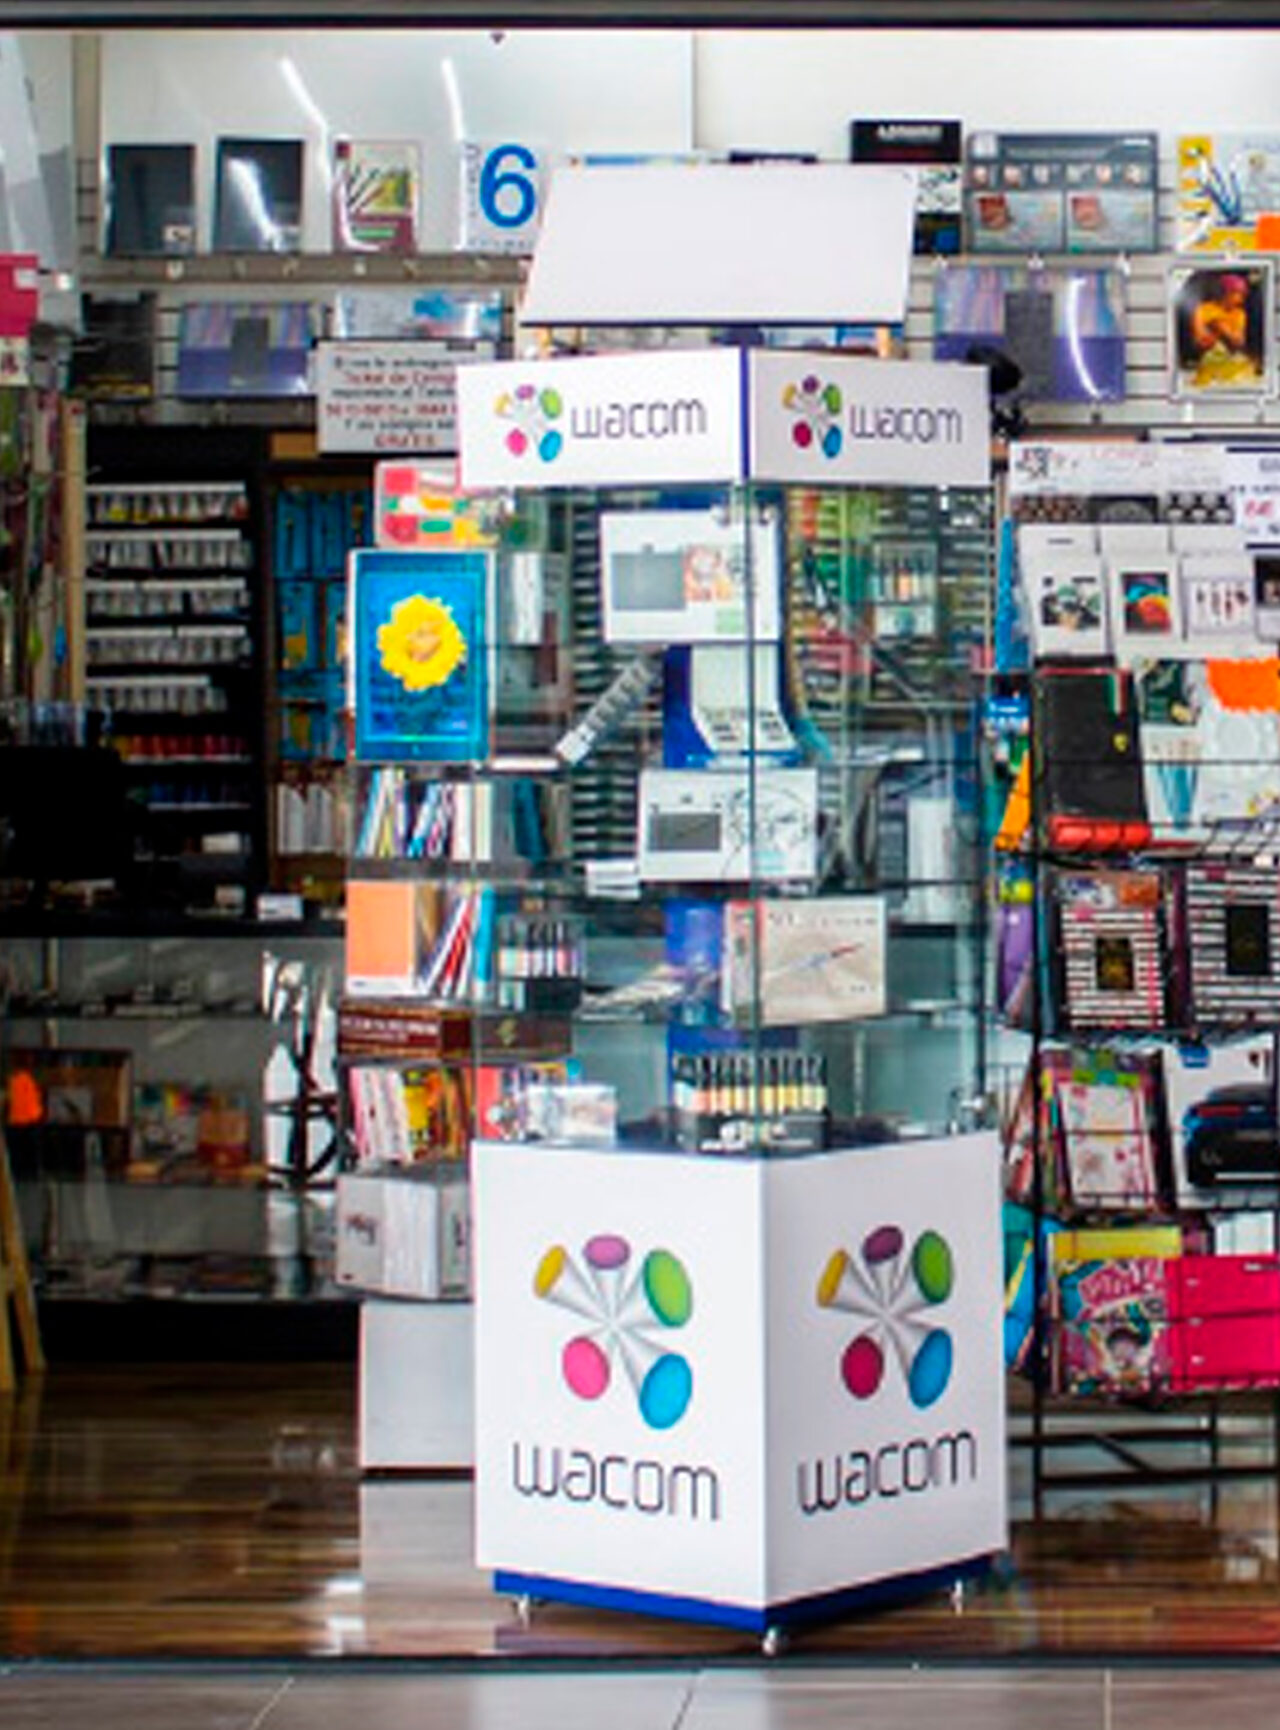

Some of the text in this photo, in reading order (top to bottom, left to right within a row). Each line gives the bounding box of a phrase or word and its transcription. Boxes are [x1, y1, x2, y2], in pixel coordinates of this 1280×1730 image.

[478, 143, 539, 230] 6
[572, 398, 705, 439] wacom
[850, 406, 962, 444] wacom
[513, 1441, 719, 1521] wacom
[797, 1430, 977, 1516] wacom
